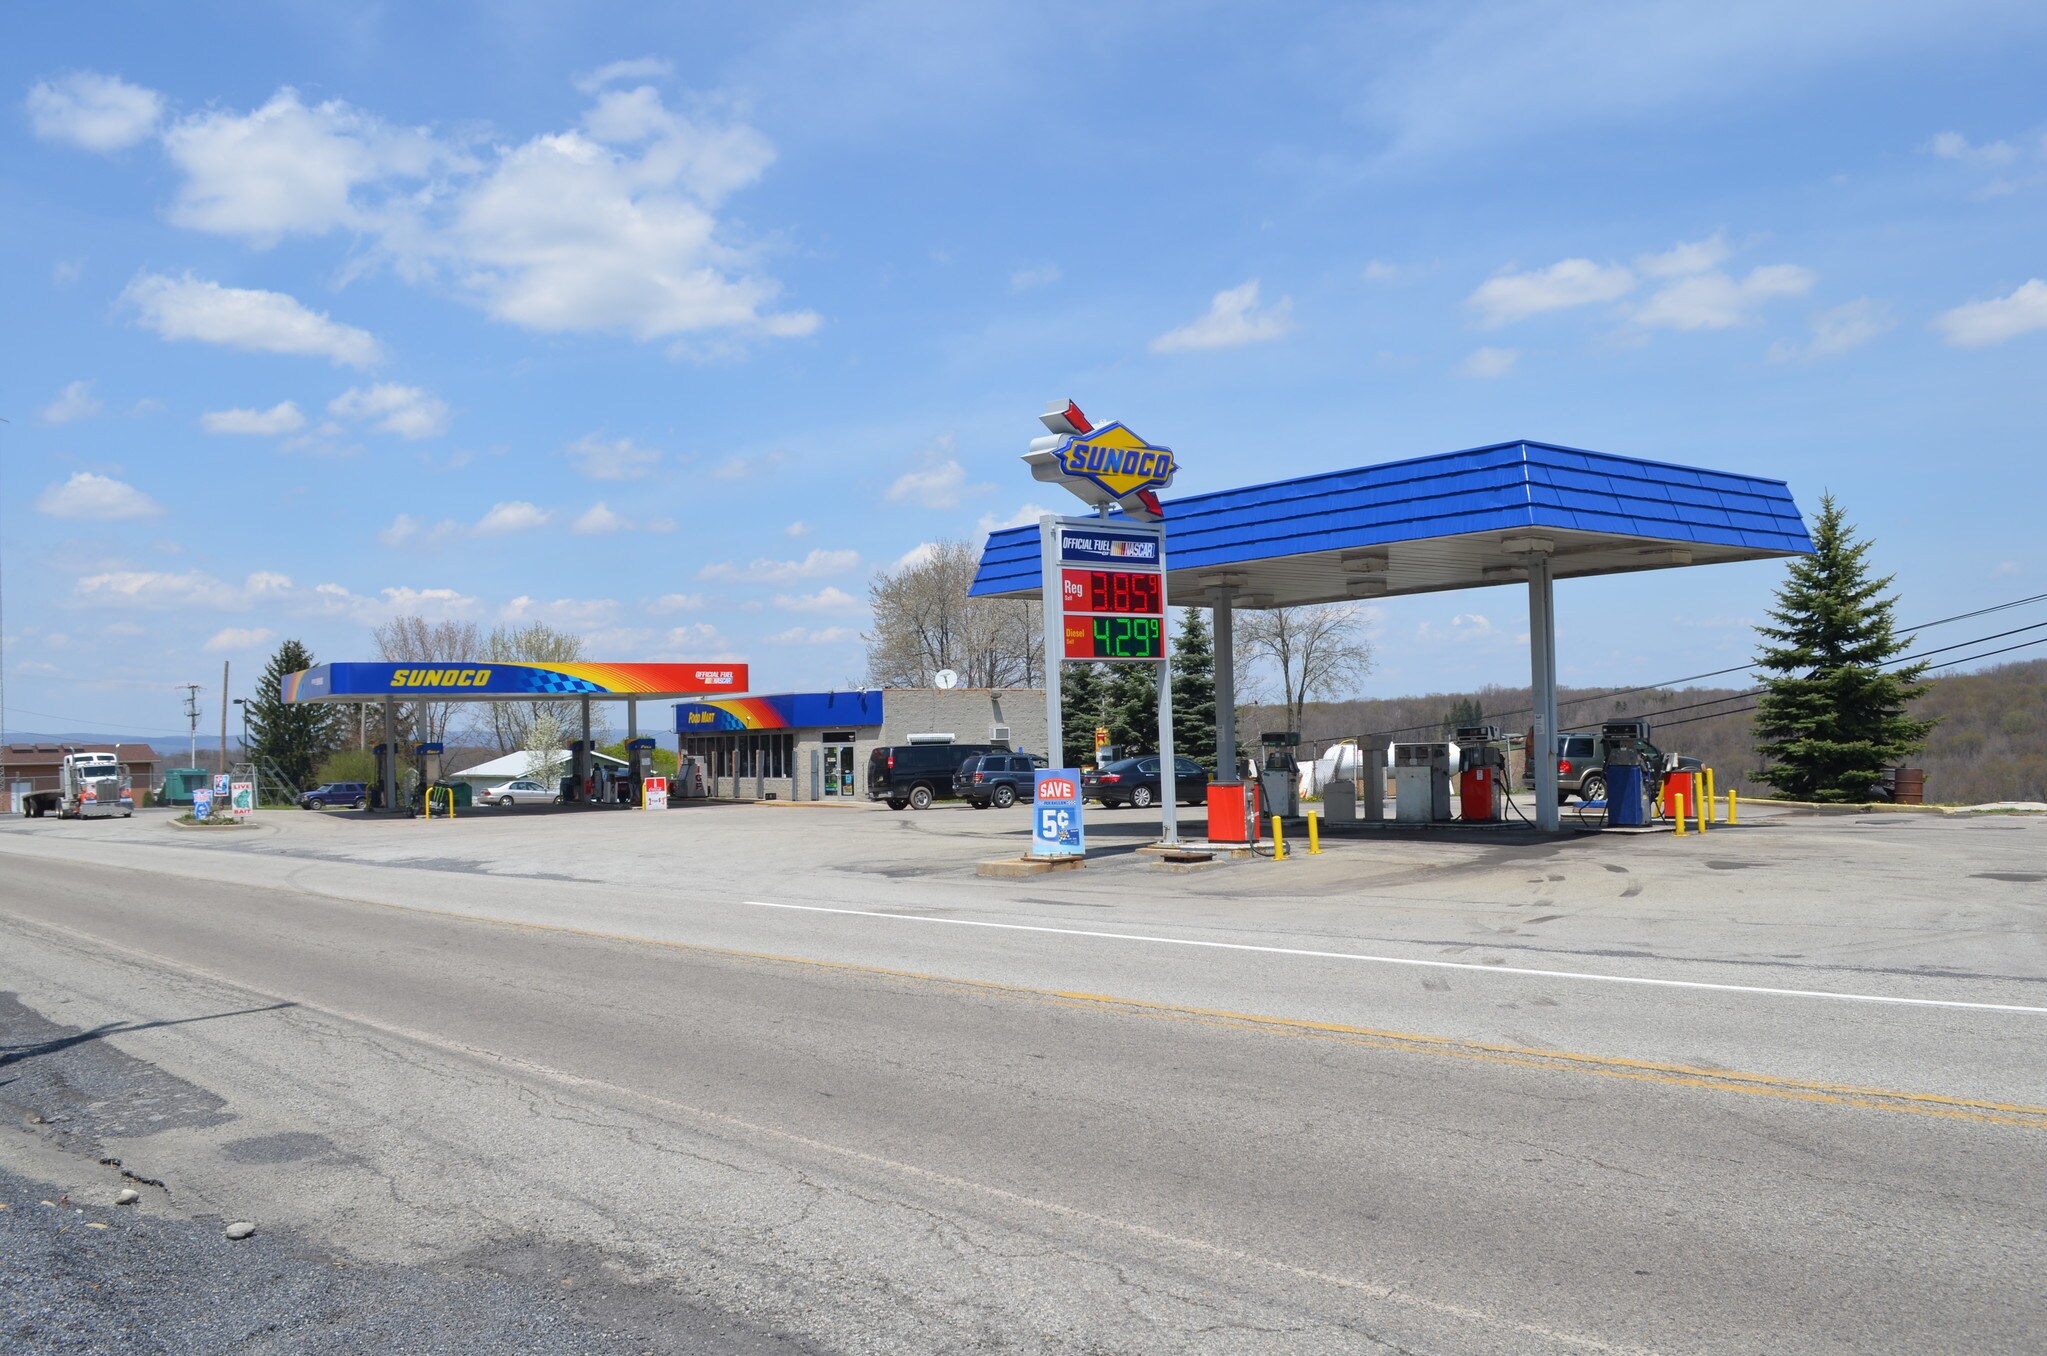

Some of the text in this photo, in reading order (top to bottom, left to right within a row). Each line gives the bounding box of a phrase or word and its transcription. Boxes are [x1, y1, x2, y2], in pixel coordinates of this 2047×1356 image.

[1070, 444, 1170, 478] SUNOCO
[1063, 537, 1111, 551] OFFICIAL FUEL
[1124, 542, 1155, 558] NASCAR
[1064, 580, 1083, 597] Reg
[1066, 628, 1085, 638] Diesel
[390, 669, 492, 687] SUNOCO
[1040, 781, 1071, 798] SAVE
